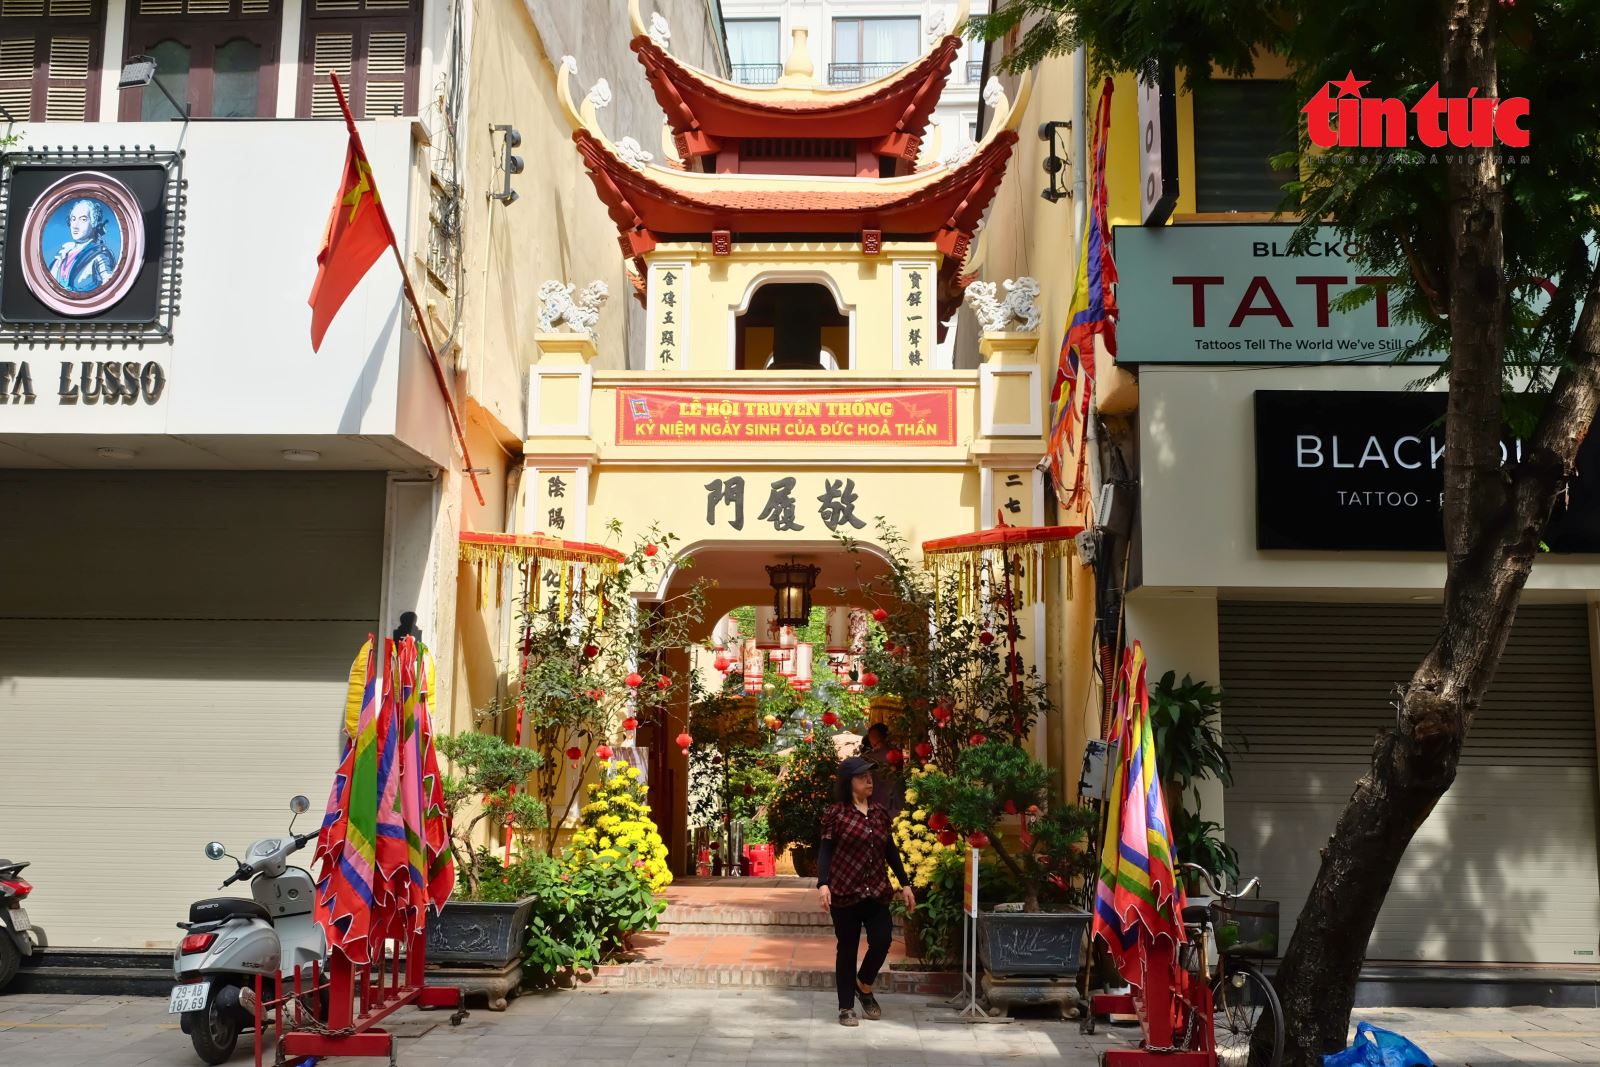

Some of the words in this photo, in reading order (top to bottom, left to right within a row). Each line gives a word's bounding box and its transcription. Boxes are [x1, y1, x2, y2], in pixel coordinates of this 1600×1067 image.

[1195, 339, 1241, 350] Tattoos
[1244, 339, 1265, 350] Tell
[1269, 339, 1292, 350] The
[1296, 339, 1333, 350] World
[1378, 339, 1401, 350] Still
[58, 361, 166, 405] LUSSO
[679, 395, 702, 417] LỄ
[705, 399, 740, 420] HỘI
[743, 397, 821, 417] TRUYỀN
[825, 396, 894, 417] THỐNG
[659, 420, 697, 438] NIỆM
[700, 419, 742, 435] NGÀY
[745, 424, 781, 436] SINH
[784, 419, 816, 436] CỦA
[820, 420, 854, 436] ĐỨC
[895, 418, 938, 436] THẦN
[1337, 491, 1419, 507] TATTOO
[176, 985, 204, 999] 29-AB
[172, 997, 204, 1012] 187.69
